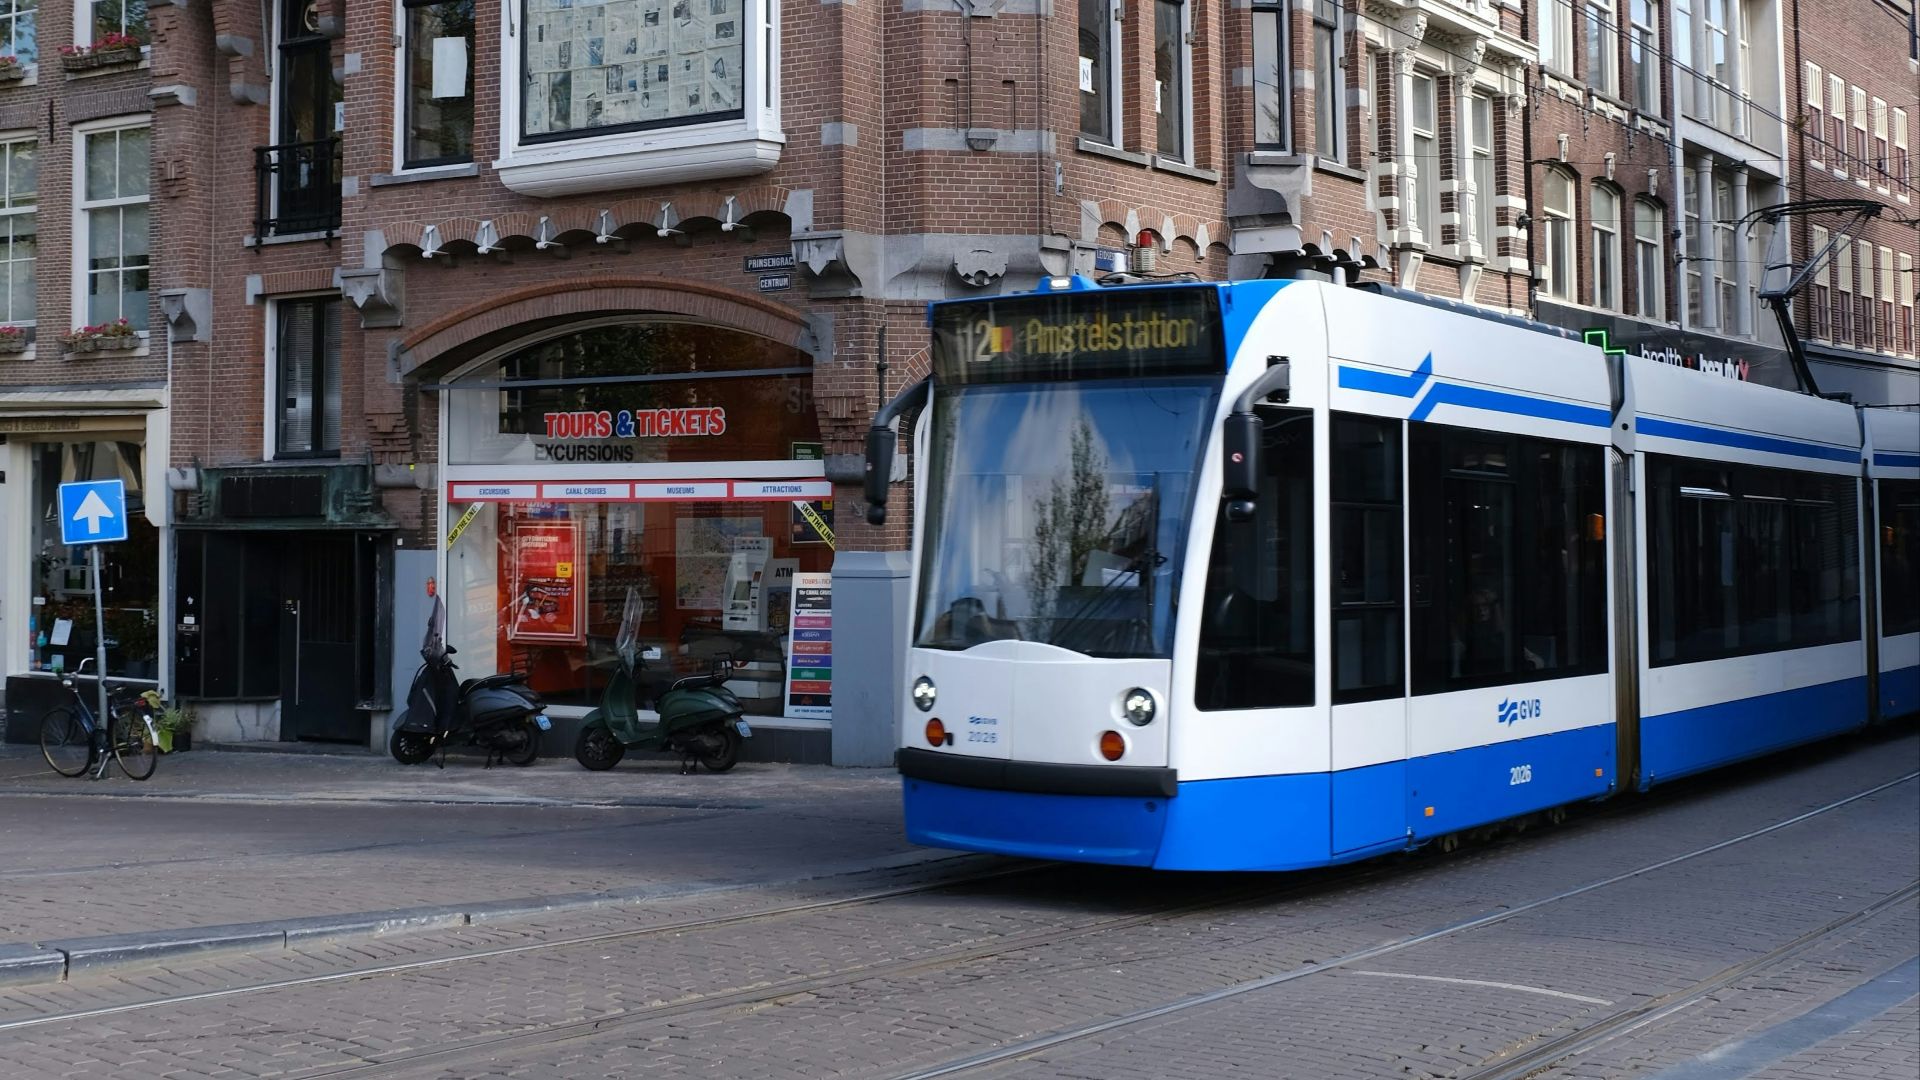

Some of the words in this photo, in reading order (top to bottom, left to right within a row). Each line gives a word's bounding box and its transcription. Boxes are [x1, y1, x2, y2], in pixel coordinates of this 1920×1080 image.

[748, 257, 796, 268] PRINSENGRAC
[760, 278, 789, 288] CENTRUM
[1026, 310, 1198, 355] Amstelstation
[544, 410, 612, 439] TOURS
[616, 410, 636, 438] &
[636, 407, 726, 437] TICKETS
[534, 443, 634, 462] EXCURSIONS
[565, 487, 583, 495] CANAL
[583, 487, 607, 495] CRUISES
[666, 486, 695, 495] MUSEUMS
[762, 485, 802, 493] ATTRACTIONS
[800, 503, 814, 518] SKIP
[812, 516, 824, 531] THE
[775, 567, 793, 577] ATM
[1520, 699, 1541, 719] GVB
[968, 731, 997, 743] 2026
[1510, 765, 1531, 785] 2026
